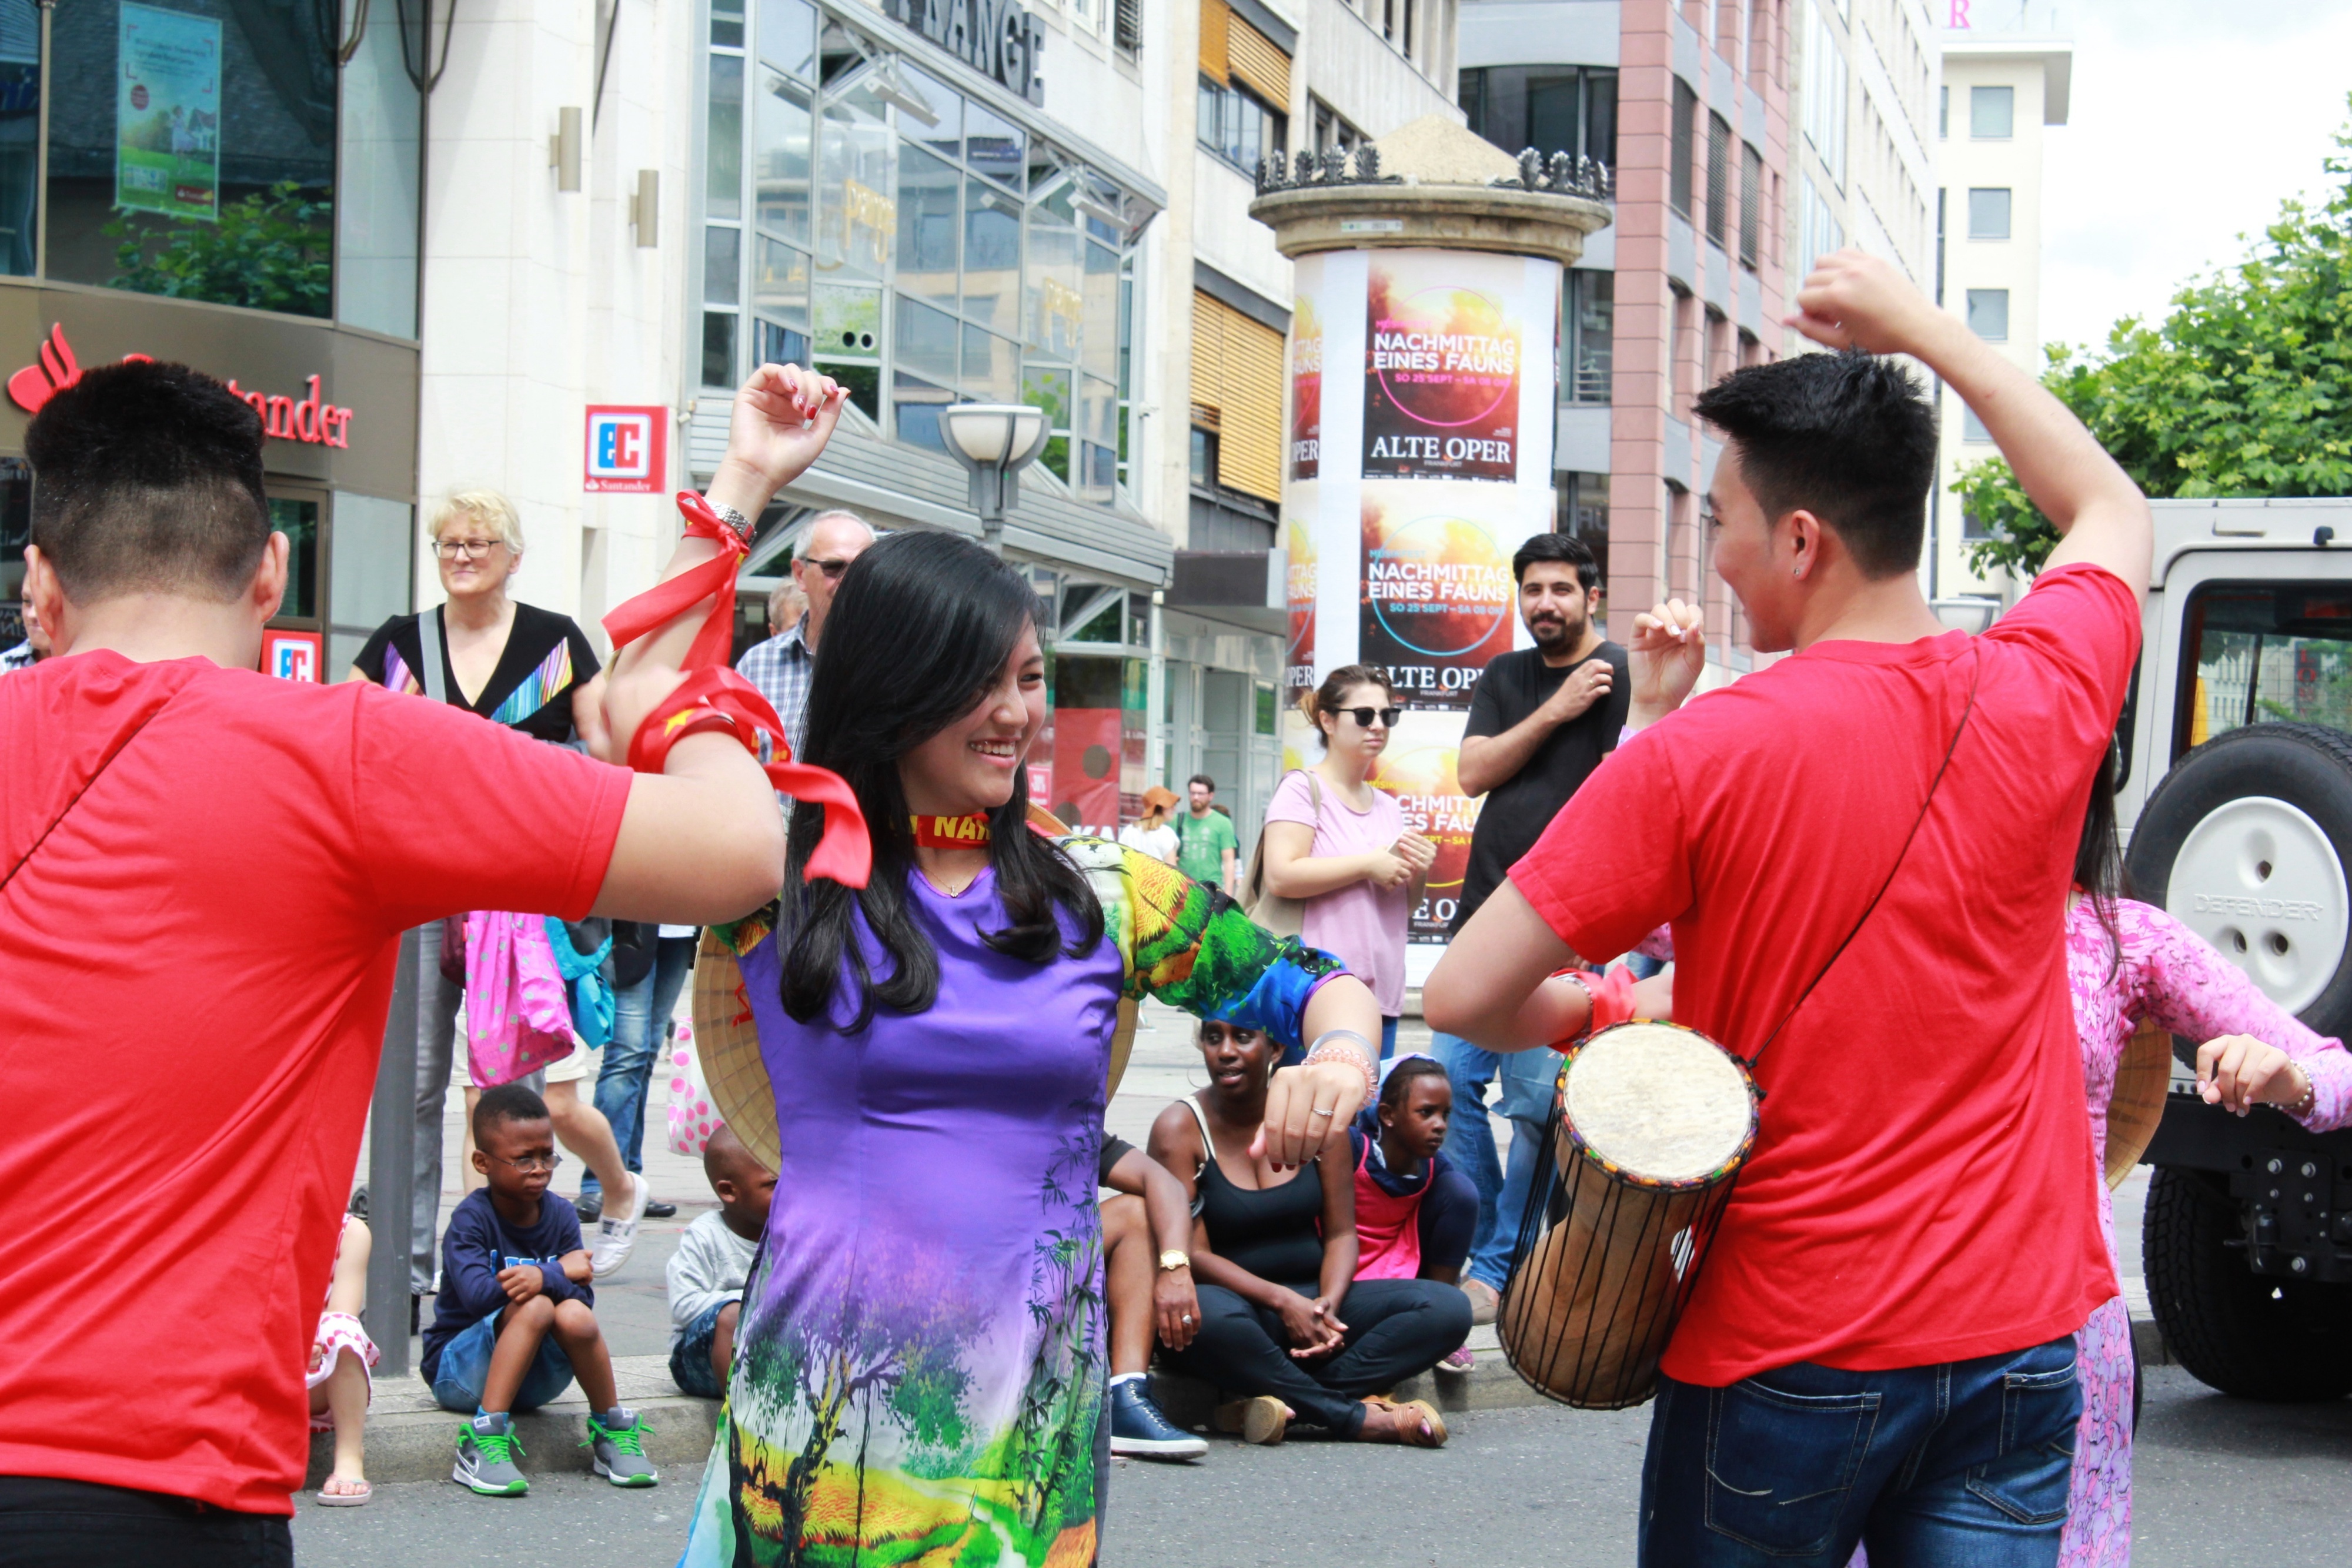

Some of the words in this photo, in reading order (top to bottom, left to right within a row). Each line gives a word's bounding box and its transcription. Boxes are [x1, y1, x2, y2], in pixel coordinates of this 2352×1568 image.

[1374, 333, 1515, 355] NACHMITTAG
[1374, 352, 1439, 370] EINES
[1445, 353, 1515, 375] FAUNS
[1395, 373, 1410, 382] SO
[1412, 373, 1425, 382] 25
[1428, 374, 1453, 383] SEPT
[1462, 376, 1476, 384] SA
[1292, 439, 1319, 463] PER
[1371, 436, 1439, 458] ALTE
[1446, 437, 1511, 463] OPER
[600, 479, 651, 491] Santander
[1369, 563, 1509, 583] NACHMITTAG
[1368, 581, 1434, 599] EINES
[1441, 583, 1509, 602] FAUNS
[1389, 603, 1405, 612] SO
[1407, 603, 1419, 612] 25
[1422, 604, 1448, 613] SEPT
[1458, 605, 1471, 614] SA
[1381, 666, 1435, 688] LTE
[1442, 667, 1485, 689] OP
[1396, 795, 1489, 815] CHMITT
[1435, 814, 1478, 832] FAU
[1452, 837, 1466, 845] SA
[2194, 894, 2323, 921] DEFENDER
